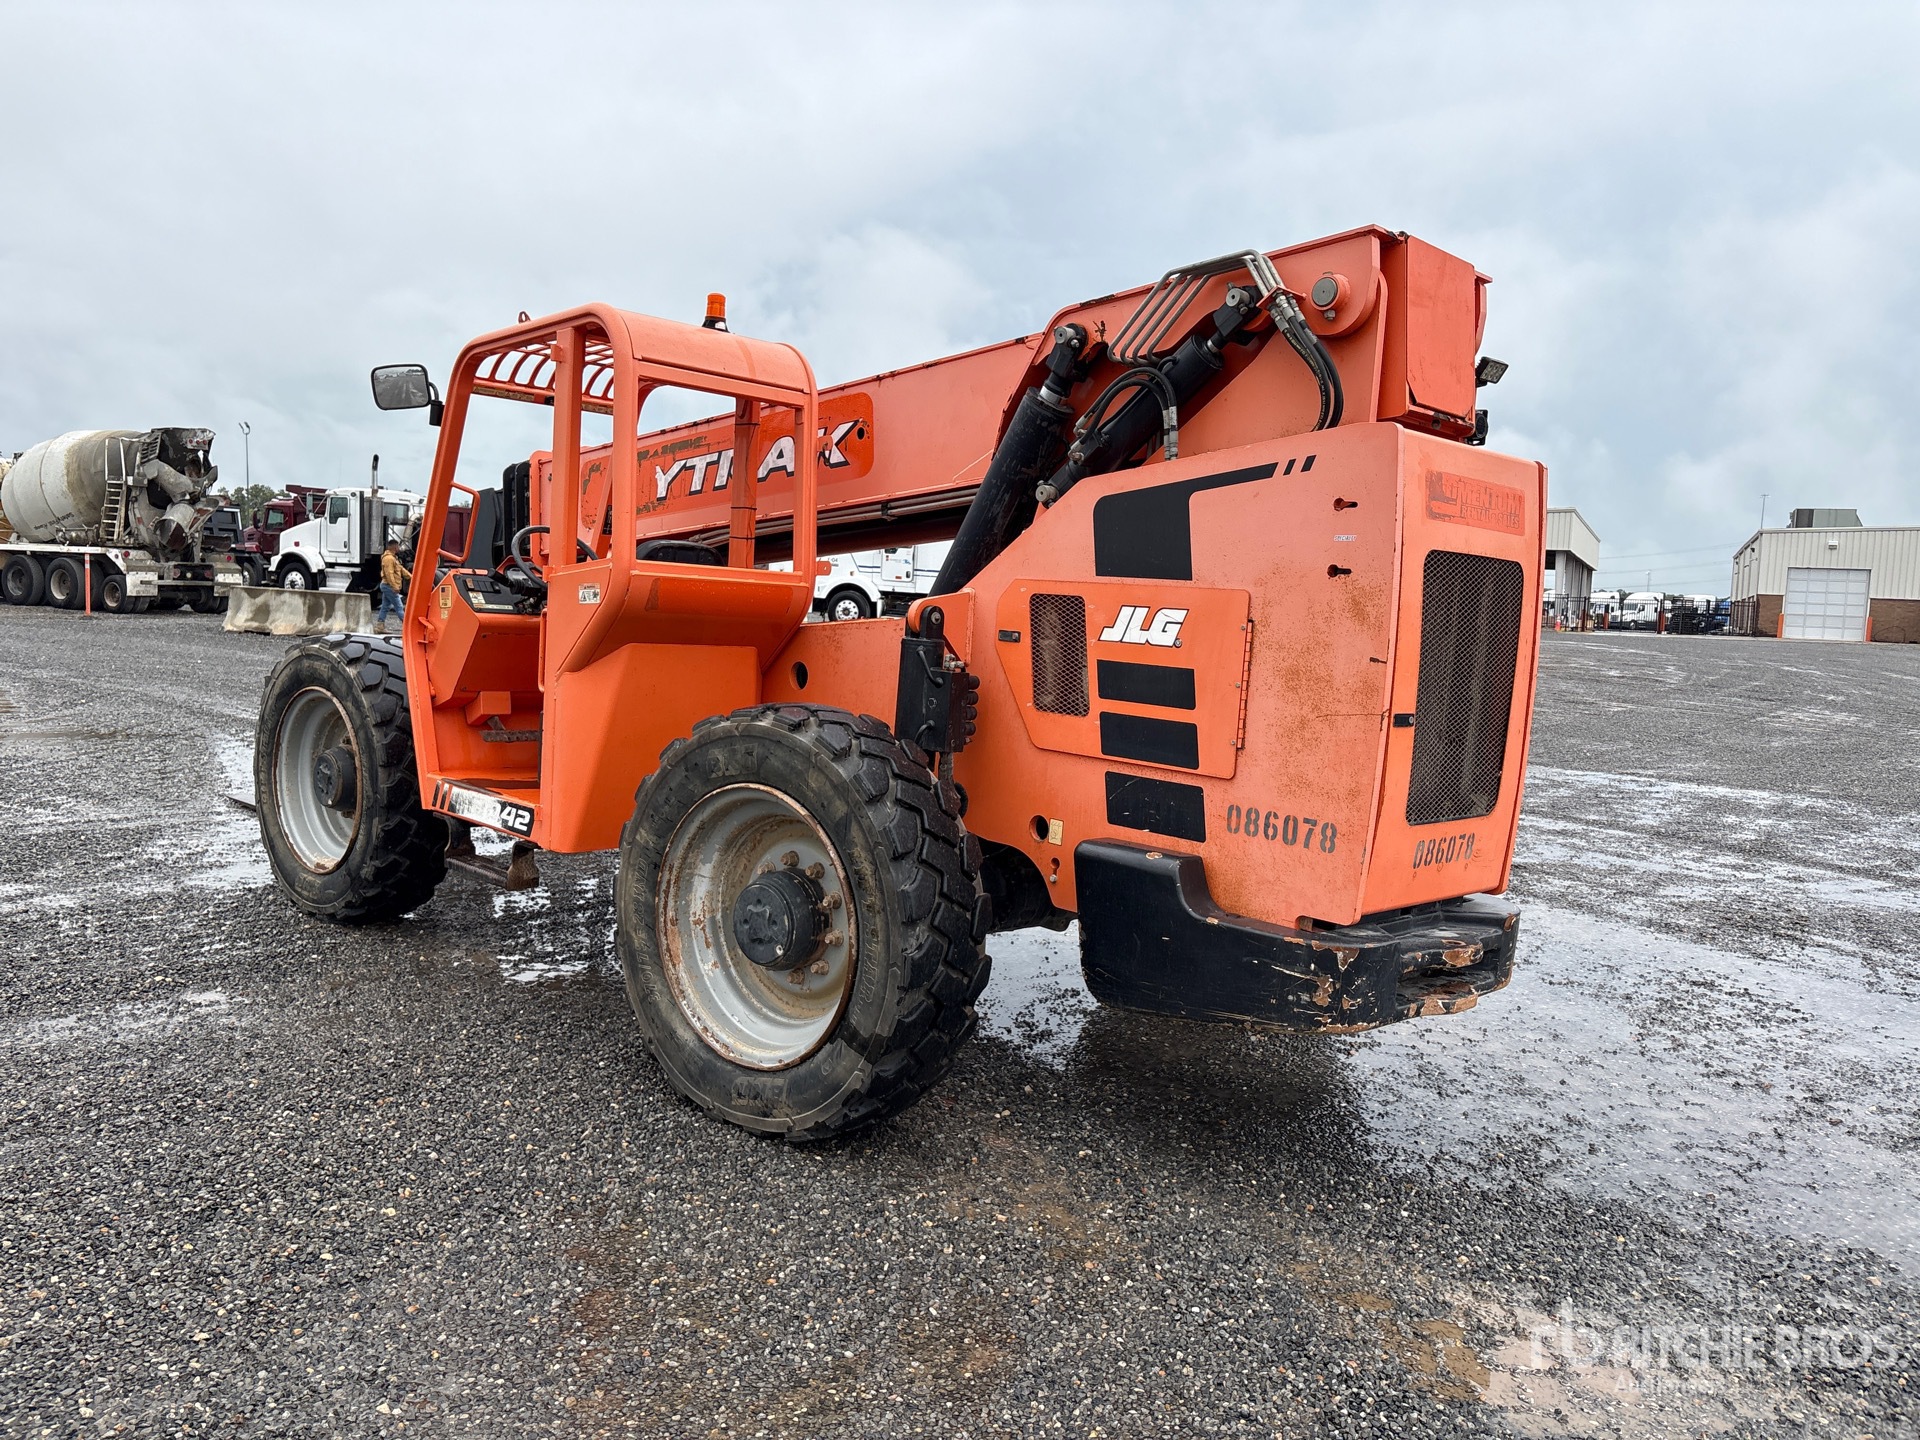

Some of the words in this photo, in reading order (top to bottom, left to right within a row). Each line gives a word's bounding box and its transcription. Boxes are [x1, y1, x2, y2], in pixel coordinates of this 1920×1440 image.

[1097, 605, 1189, 647] JLG
[1226, 804, 1338, 854] 086078
[1413, 832, 1475, 870] 086078
